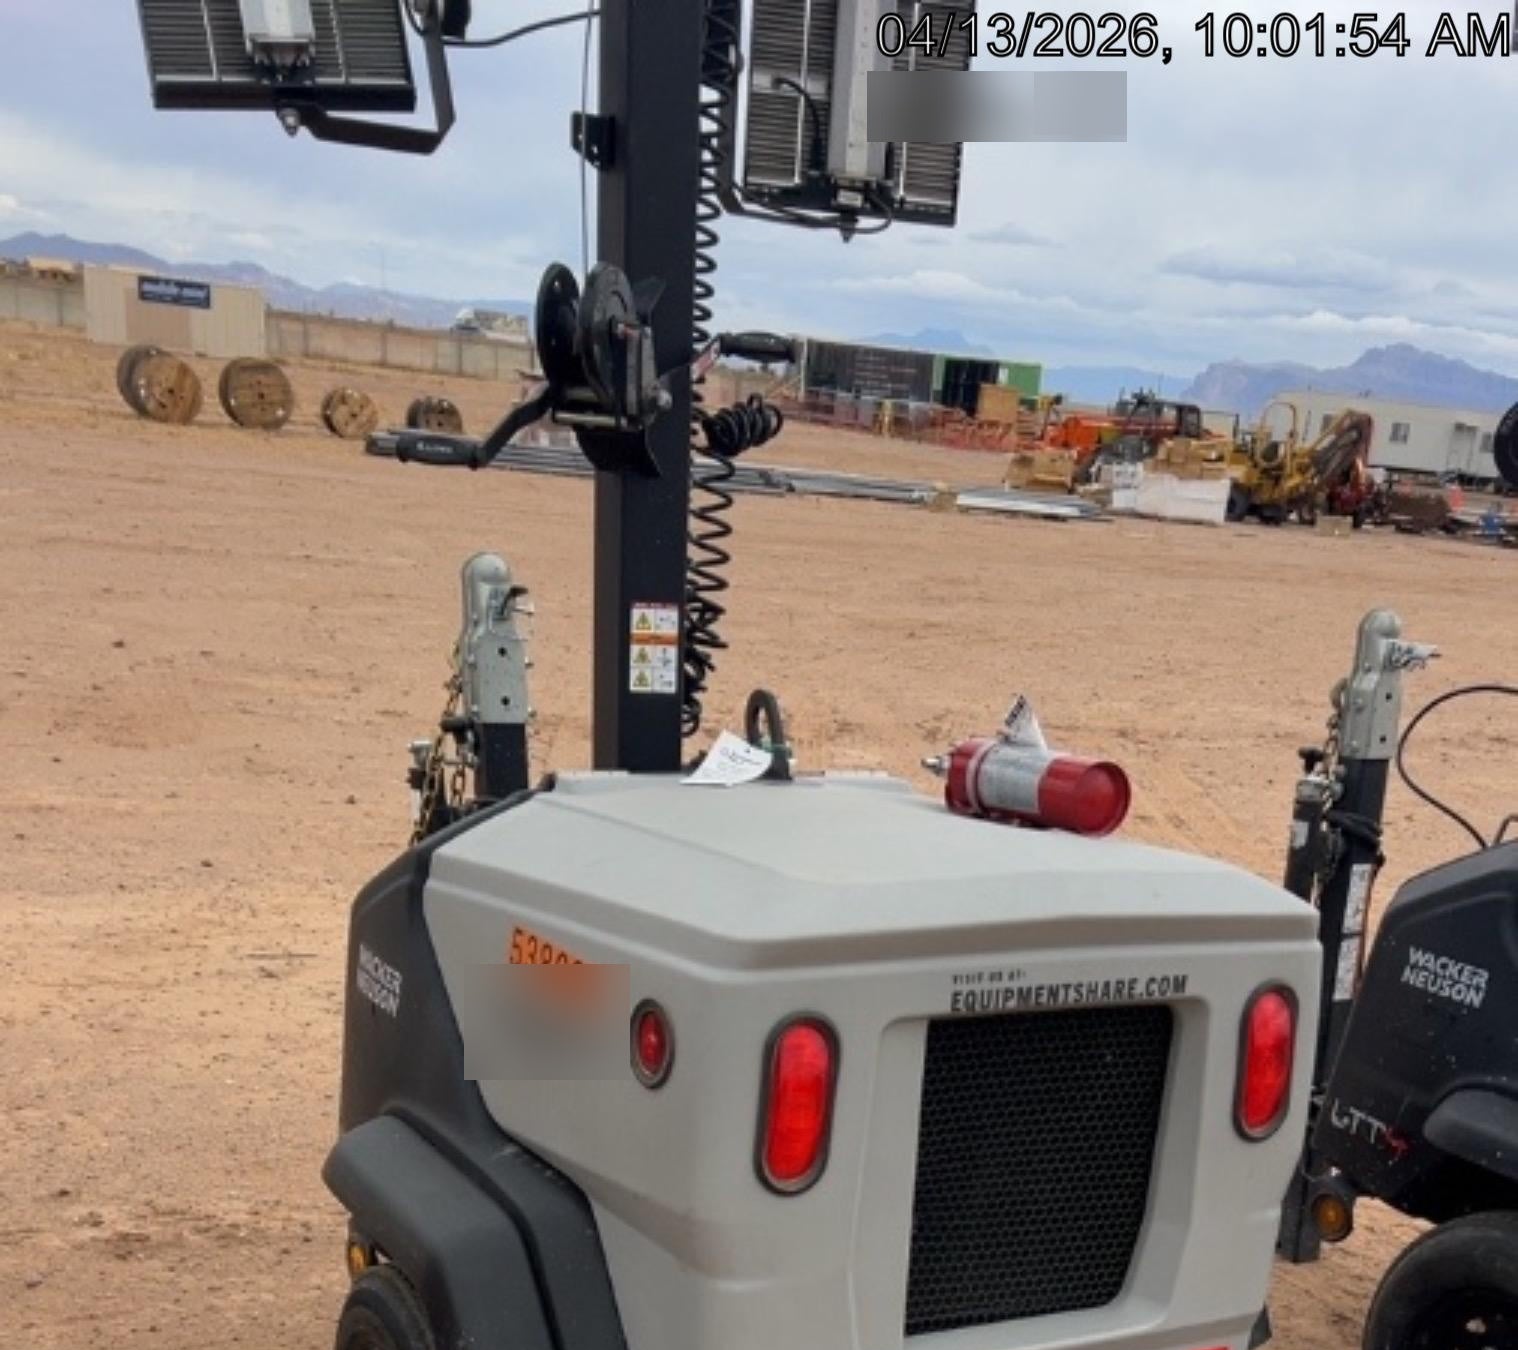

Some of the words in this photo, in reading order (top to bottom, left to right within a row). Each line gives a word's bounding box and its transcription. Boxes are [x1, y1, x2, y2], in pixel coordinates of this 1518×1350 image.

[1400, 966, 1485, 1009] NEUSON
[1408, 945, 1489, 988] WACKER
[951, 975, 1188, 1012] EQUIPMENTSHARE.COM
